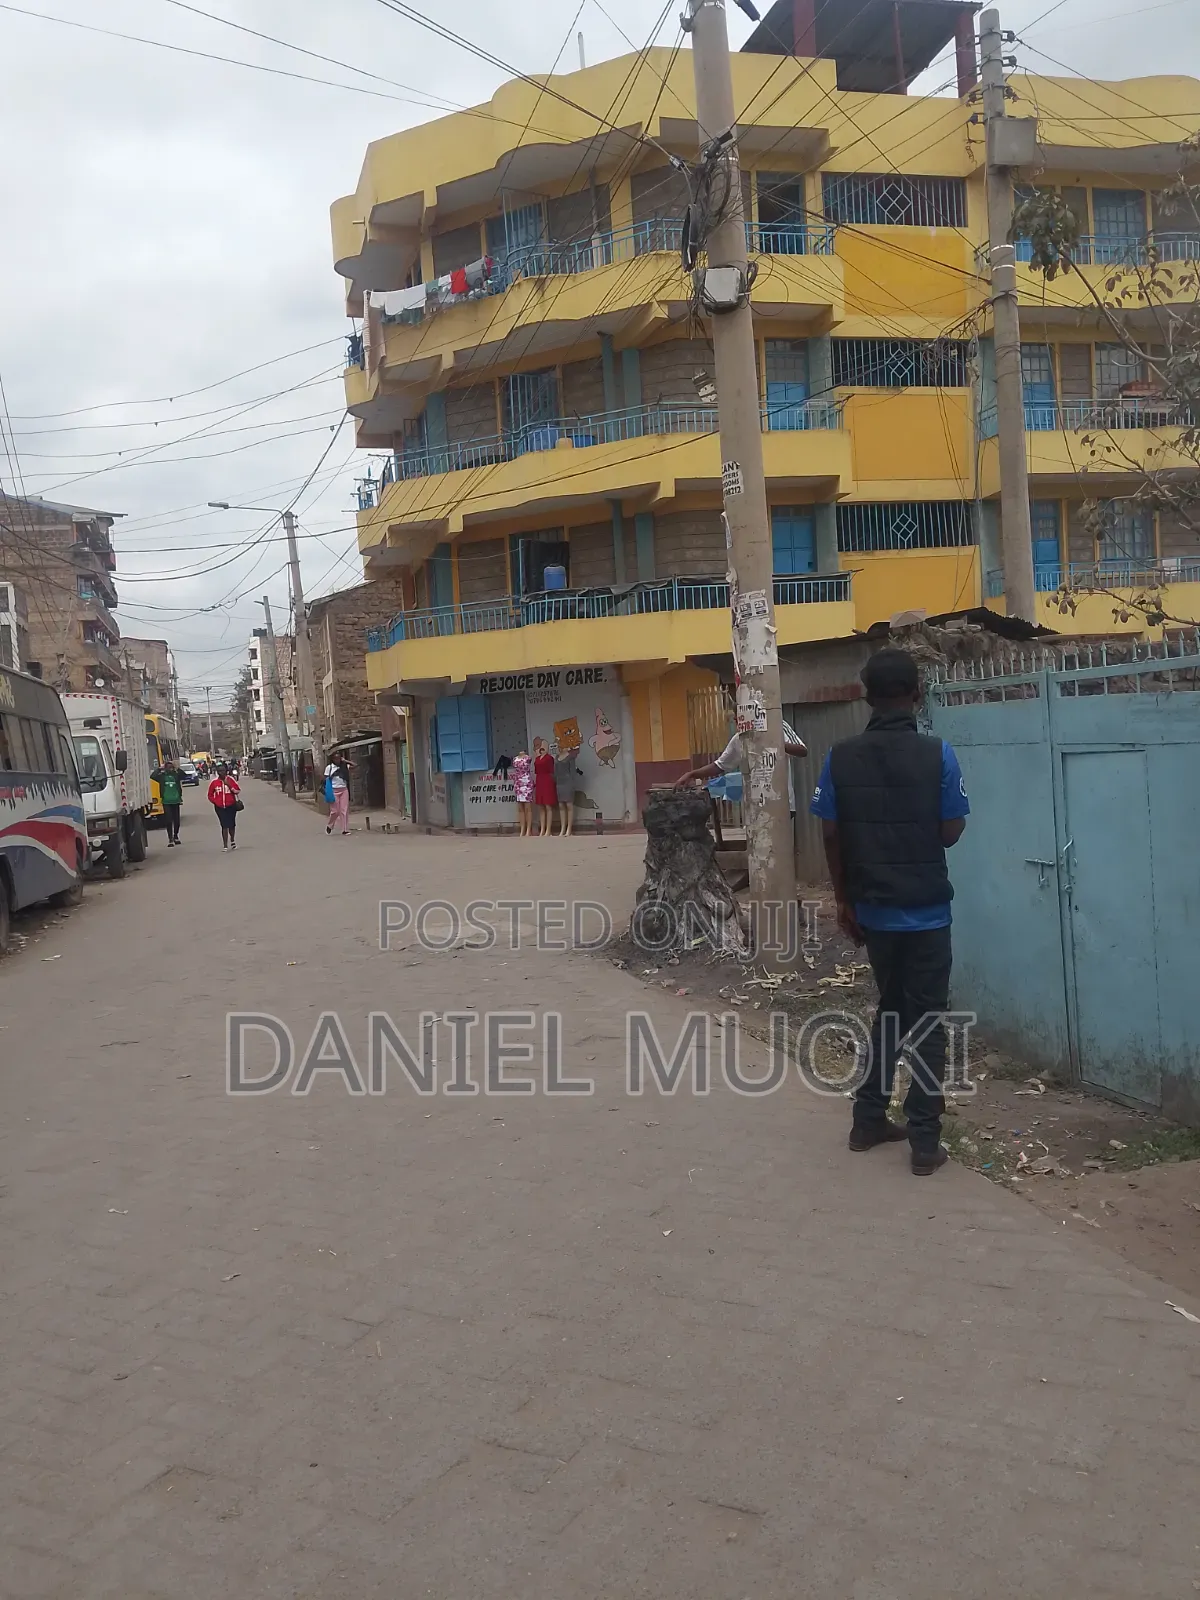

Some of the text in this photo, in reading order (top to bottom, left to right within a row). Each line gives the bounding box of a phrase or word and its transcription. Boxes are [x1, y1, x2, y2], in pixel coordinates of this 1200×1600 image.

[480, 668, 608, 693] REJOICE DAY CARE.
